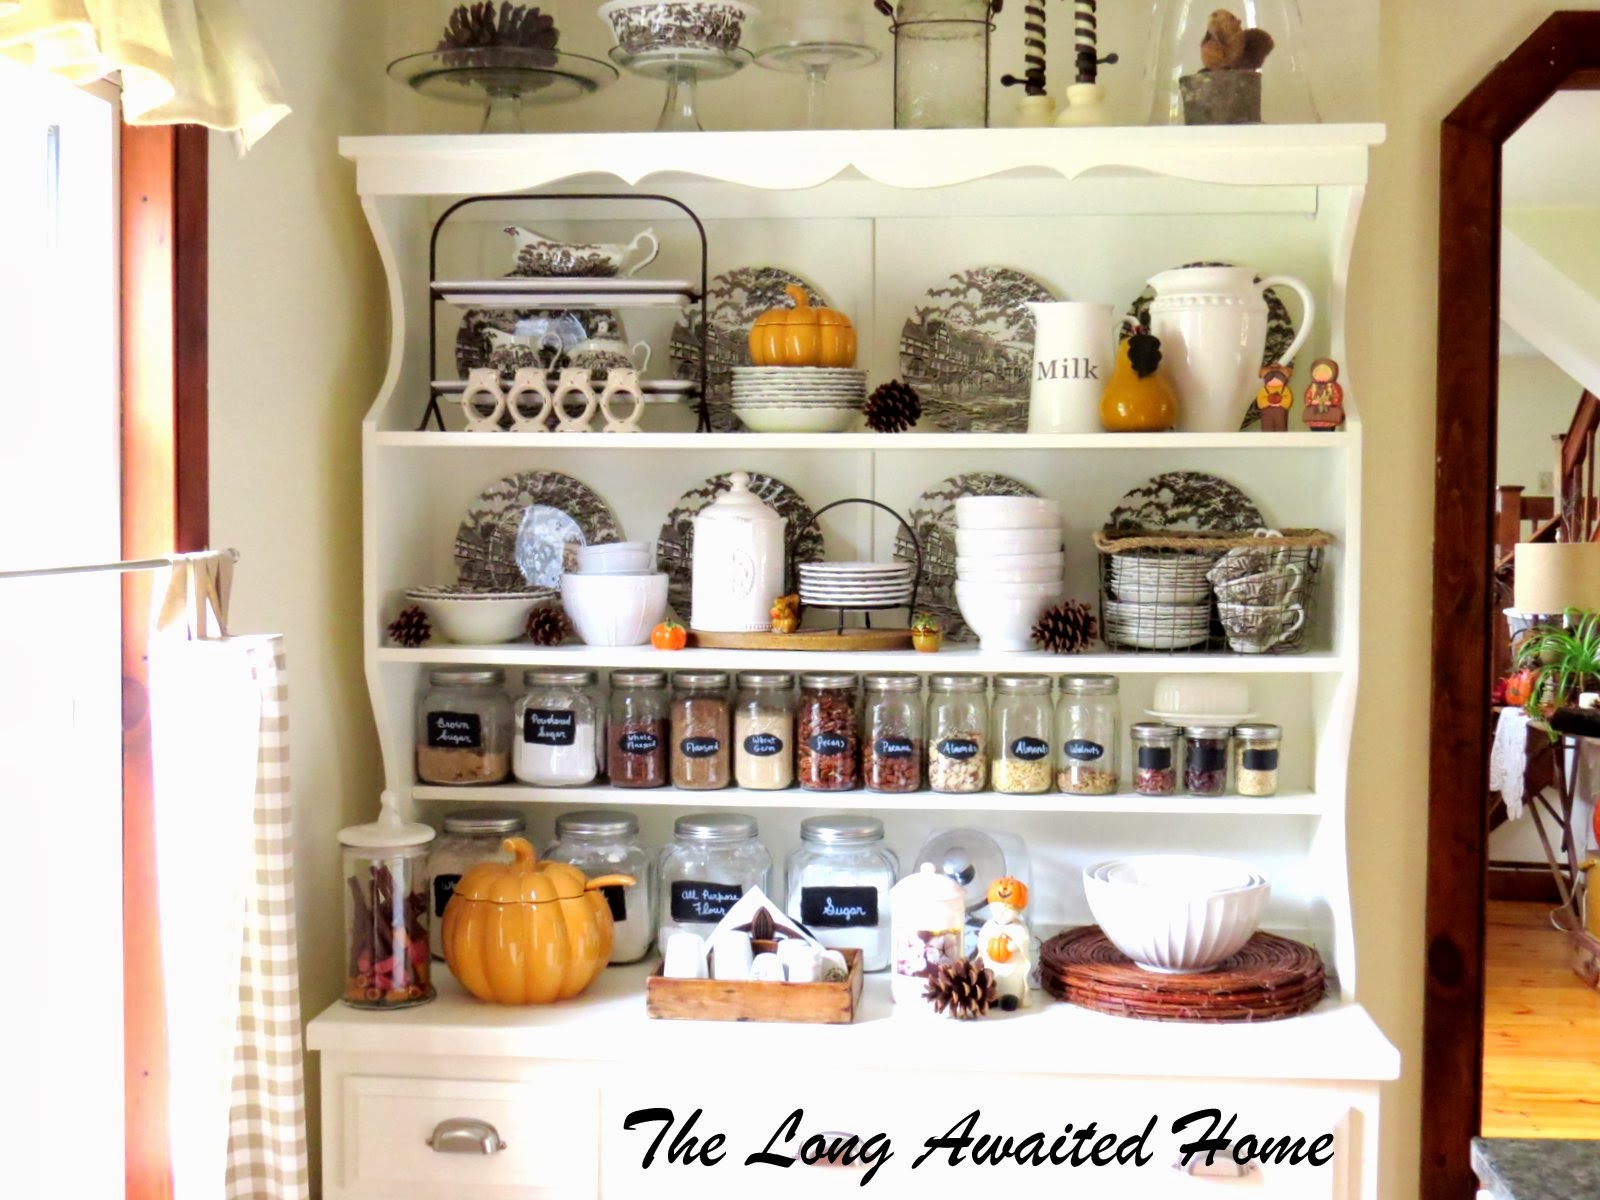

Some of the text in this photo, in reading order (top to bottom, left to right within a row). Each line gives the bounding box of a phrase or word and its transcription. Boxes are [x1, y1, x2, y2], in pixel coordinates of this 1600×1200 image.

[1037, 357, 1099, 381] Milk
[436, 717, 471, 730] Brown
[436, 729, 473, 744] Sugar
[537, 726, 567, 741] Sugar
[681, 889, 739, 901] All Purpose
[692, 902, 726, 916] Flour
[822, 896, 867, 920] Sugar
